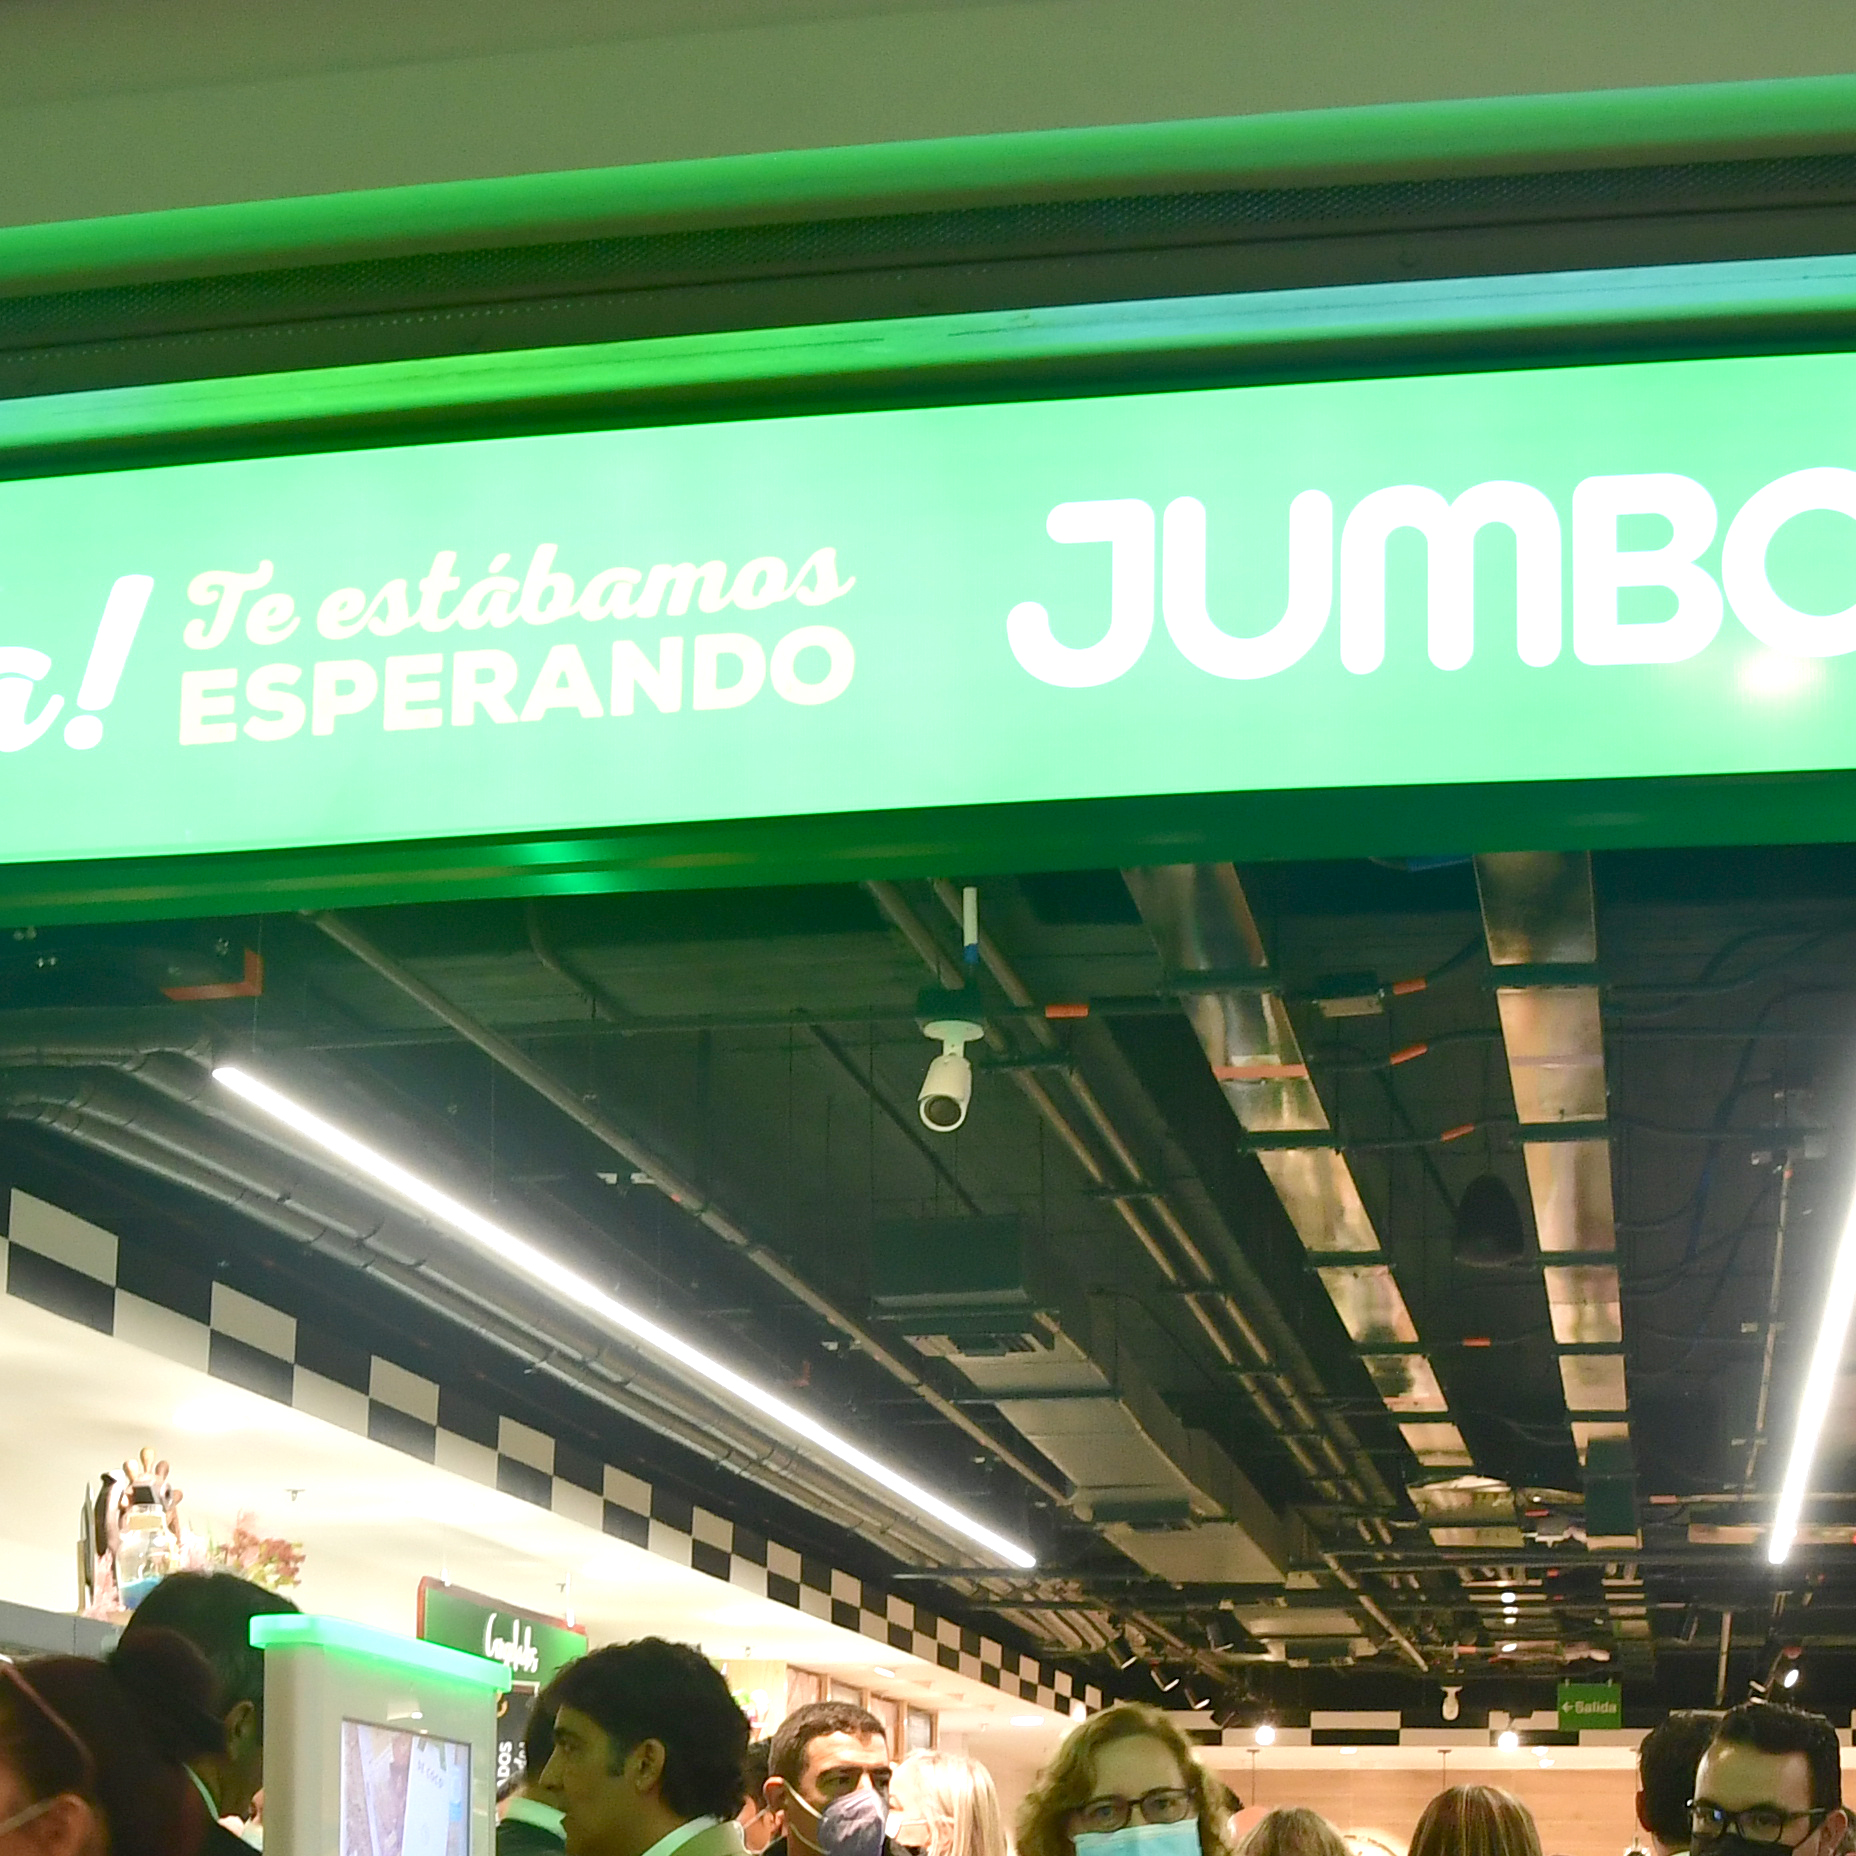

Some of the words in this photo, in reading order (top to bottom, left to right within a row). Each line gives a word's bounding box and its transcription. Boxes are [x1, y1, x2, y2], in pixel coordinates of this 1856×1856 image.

[182, 560, 302, 650] Te
[316, 543, 857, 640] estábamos
[178, 625, 856, 746] ESPERANDO
[1574, 1700, 1618, 1714] Salida
